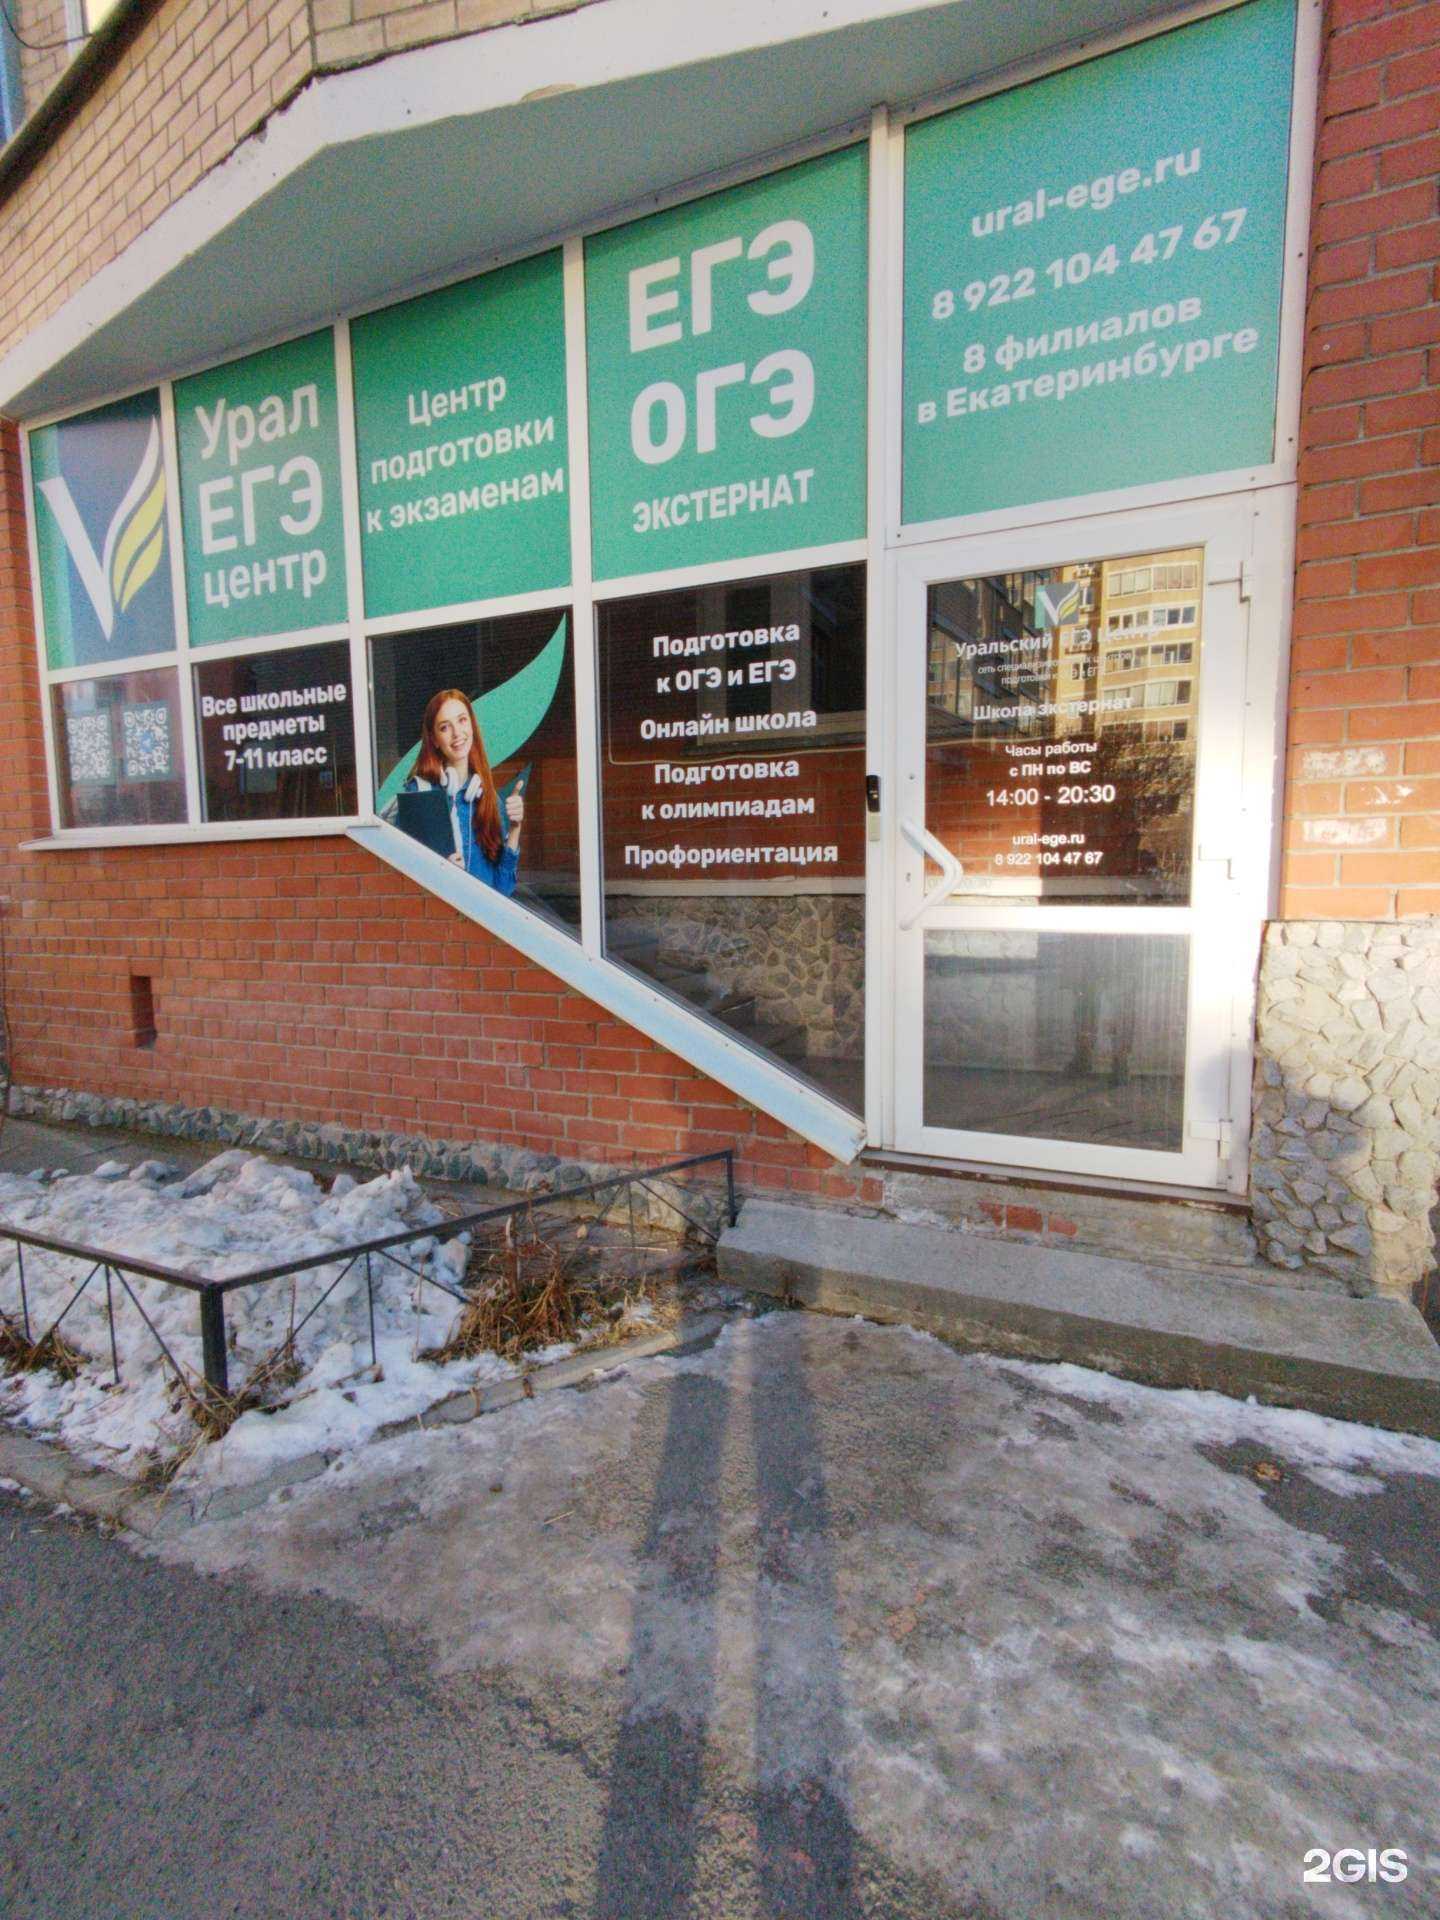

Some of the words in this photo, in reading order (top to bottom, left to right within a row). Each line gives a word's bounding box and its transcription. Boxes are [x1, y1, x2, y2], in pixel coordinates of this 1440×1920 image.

[971, 147, 1201, 238] ural-ege.ru
[932, 289, 955, 320] 8
[963, 267, 1035, 312] 922
[1046, 244, 1120, 289] 104
[1129, 225, 1184, 265] 47
[1193, 207, 1248, 251] 67
[628, 220, 815, 353] ЕГЭ
[963, 343, 986, 374] 8
[994, 297, 1202, 372] филиалов
[917, 399, 937, 424] в
[946, 326, 1259, 417] Екатеринбурге
[408, 376, 506, 427] Центр
[631, 349, 815, 465] ОГЭ
[196, 383, 319, 466] Урал
[371, 416, 555, 484] подготовки
[200, 455, 323, 555] ЕГЭ
[366, 509, 383, 533] к
[390, 469, 564, 528] экзаменам
[632, 469, 815, 533] ЭКСТЕРНАТ
[204, 549, 327, 608] центр
[653, 624, 800, 657] Подготовка
[955, 633, 1053, 658] Уральский
[657, 676, 671, 693] к
[675, 667, 722, 692] ОГЭ
[727, 669, 743, 686] и
[749, 659, 796, 684] ЕГЭ
[202, 696, 237, 717] Все
[240, 683, 347, 712] школьные
[973, 704, 1035, 720] Школа
[223, 714, 325, 743] предметы
[640, 713, 729, 740] Онлайн
[735, 710, 817, 732] школа
[225, 750, 265, 771] 7-11
[268, 747, 327, 768] класс
[1005, 745, 1041, 756] Часы
[1045, 741, 1097, 757] работы
[654, 760, 800, 785] Подготовка
[1009, 767, 1018, 777] с
[1022, 763, 1043, 776] ПН
[1046, 765, 1066, 775] по
[1069, 761, 1091, 774] ВС
[642, 804, 655, 820] к
[659, 798, 815, 819] олимпиадам
[986, 788, 1039, 806] 14:00
[1057, 784, 1116, 804] 20:30
[625, 845, 838, 868] Профориентация
[1012, 833, 1085, 847] ural-ege.ru
[995, 854, 1003, 865] 8
[1007, 853, 1031, 865] 922
[1035, 852, 1060, 864] 104
[1064, 852, 1081, 864] 47
[1084, 852, 1103, 864] 67
